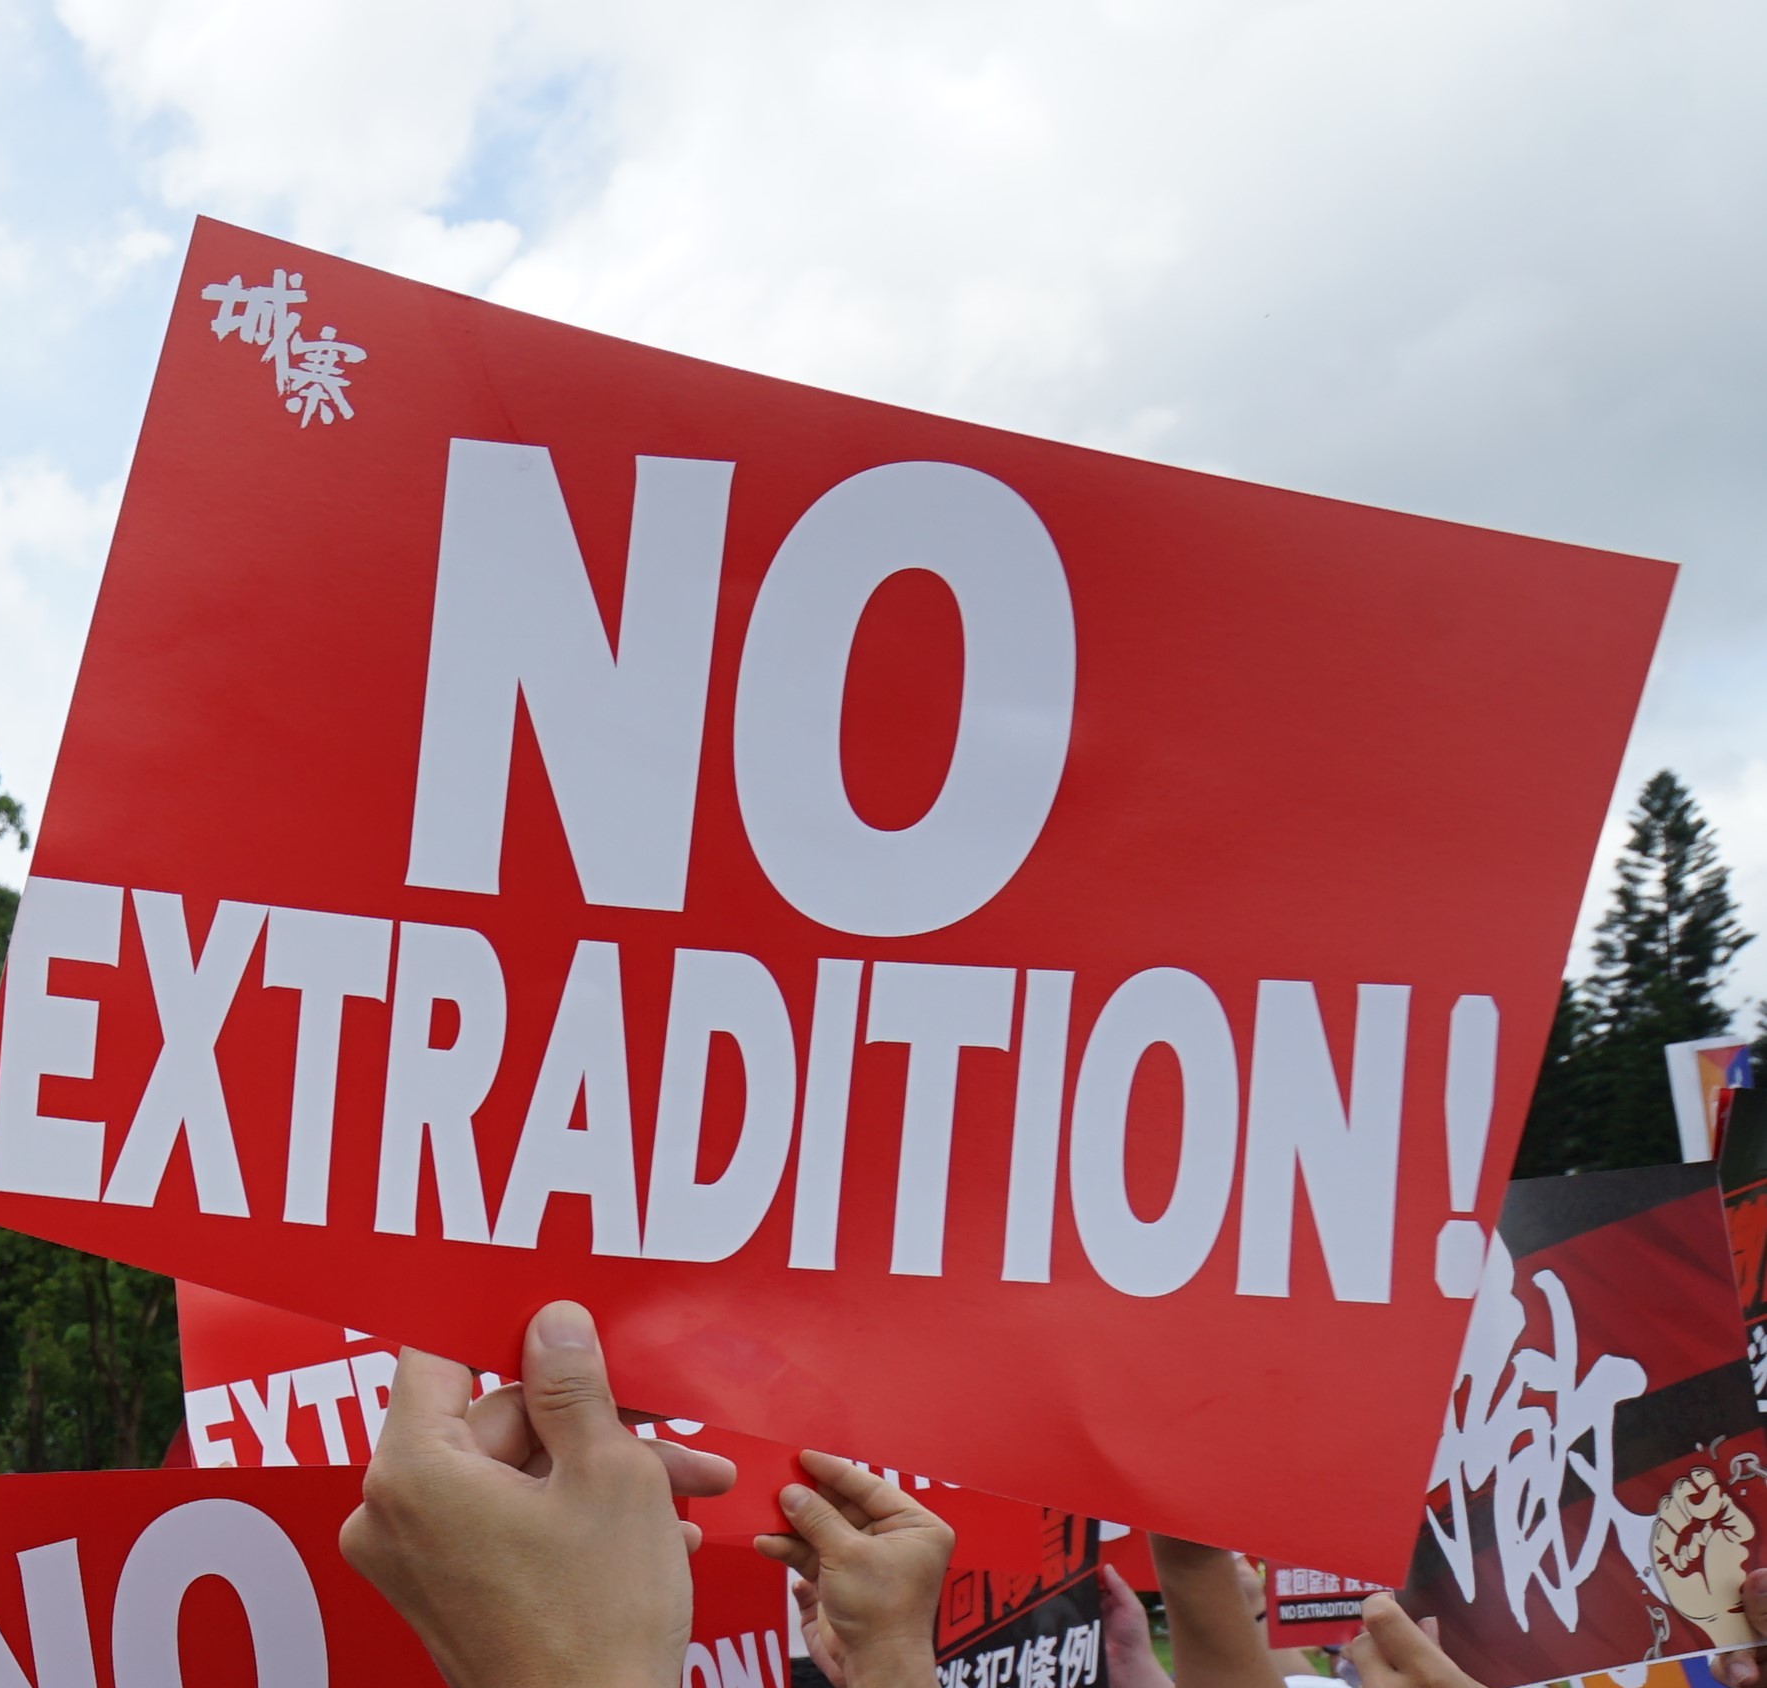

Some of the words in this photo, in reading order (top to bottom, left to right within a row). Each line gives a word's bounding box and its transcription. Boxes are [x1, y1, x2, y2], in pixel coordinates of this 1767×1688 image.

[201, 268, 366, 428] 城寨
[404, 438, 1076, 938] NO
[1280, 1604, 1295, 1621] NO
